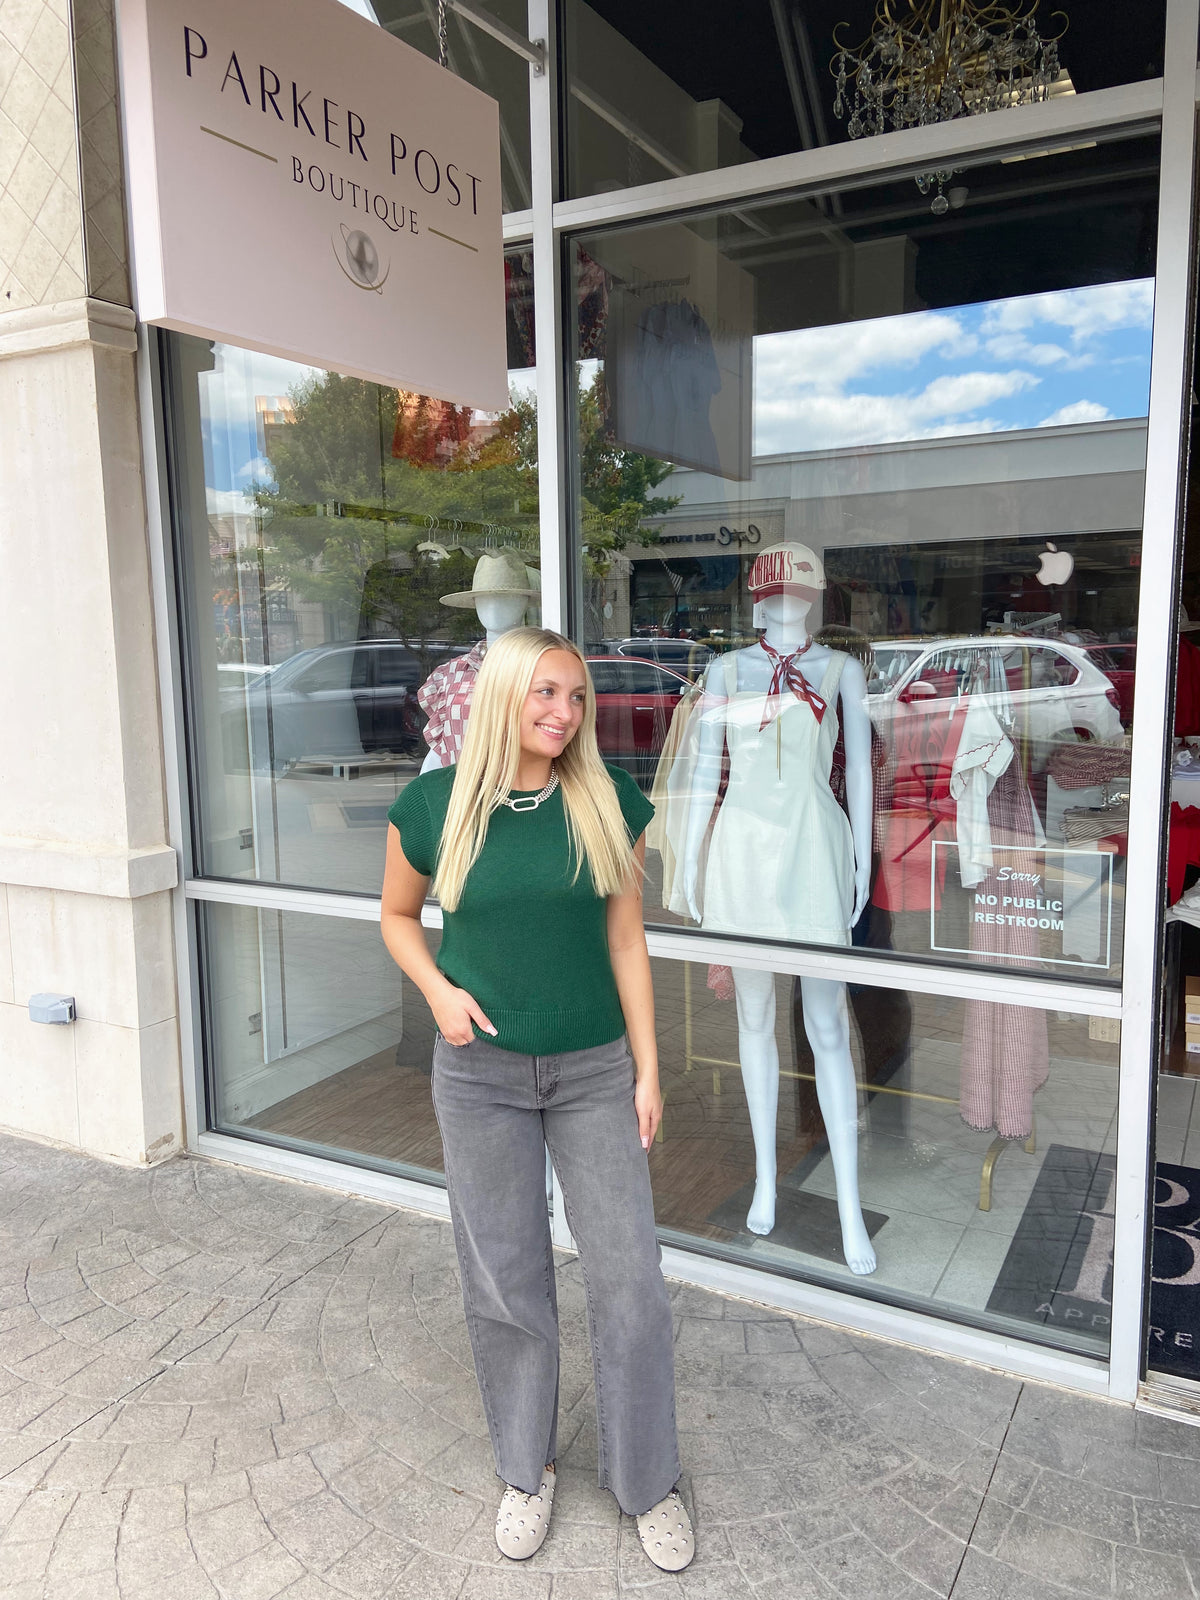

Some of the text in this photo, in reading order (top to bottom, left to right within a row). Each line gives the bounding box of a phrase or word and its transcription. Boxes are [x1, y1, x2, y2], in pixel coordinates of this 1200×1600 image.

[183, 25, 483, 216] PARKER POST
[291, 155, 420, 235] BOUTIQUE
[996, 866, 1041, 887] Sorry
[974, 893, 1063, 912] NO PUBLIC
[974, 911, 1064, 931] RESTROOM
